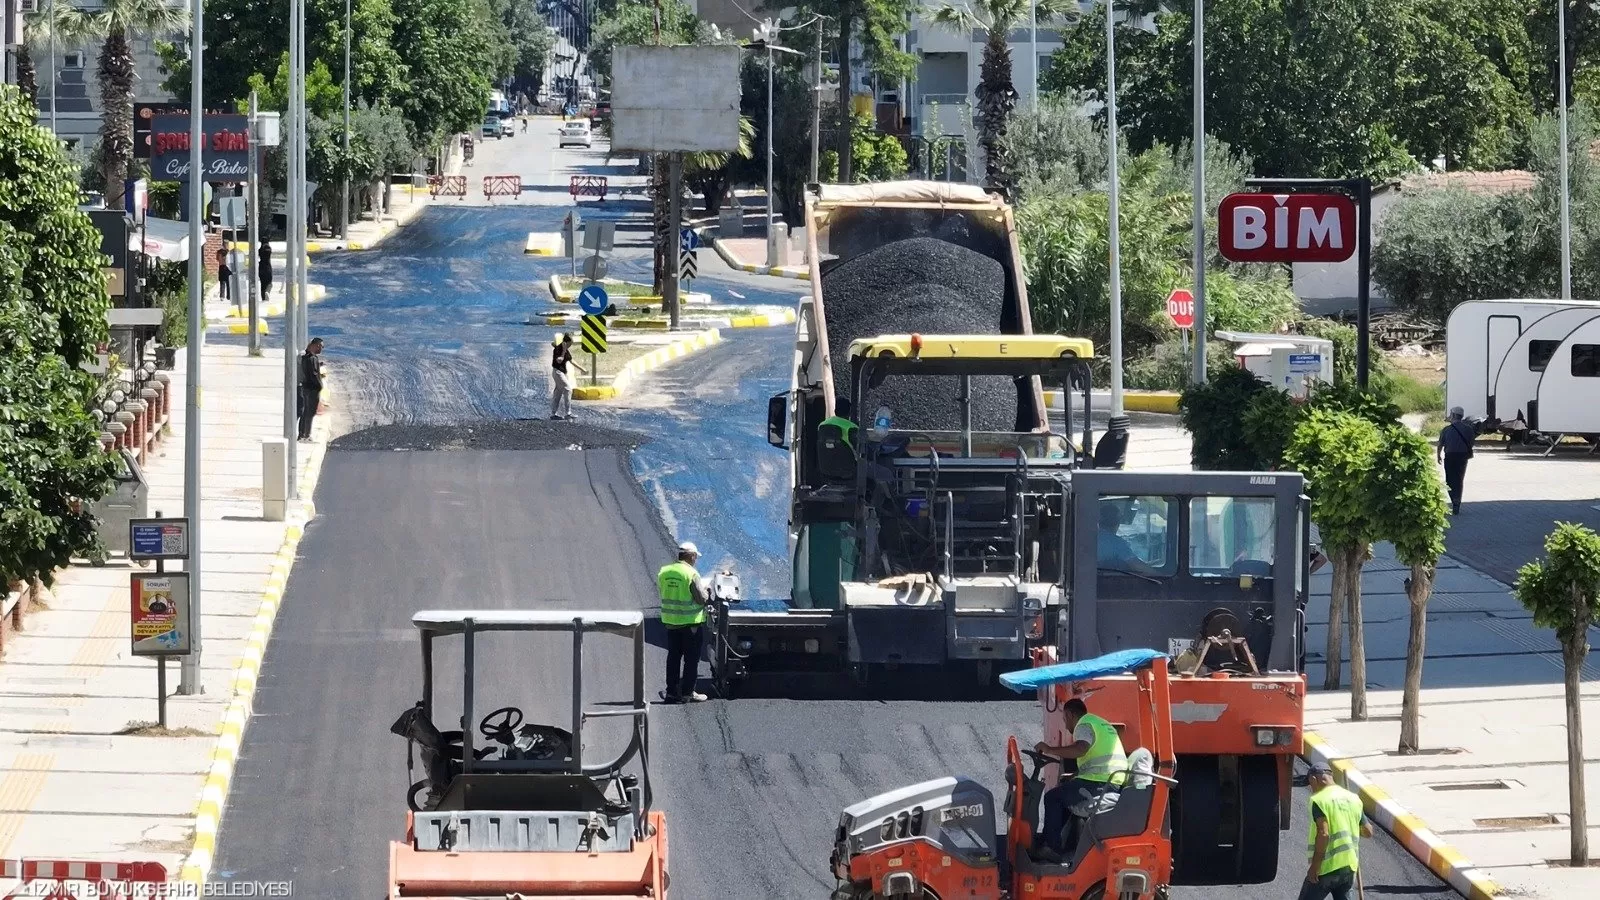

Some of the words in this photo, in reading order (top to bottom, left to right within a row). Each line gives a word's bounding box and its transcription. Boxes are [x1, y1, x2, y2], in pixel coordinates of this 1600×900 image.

[208, 158, 248, 175] Bistro
[1233, 194, 1344, 250] BİM
[1250, 476, 1276, 485] HAMM
